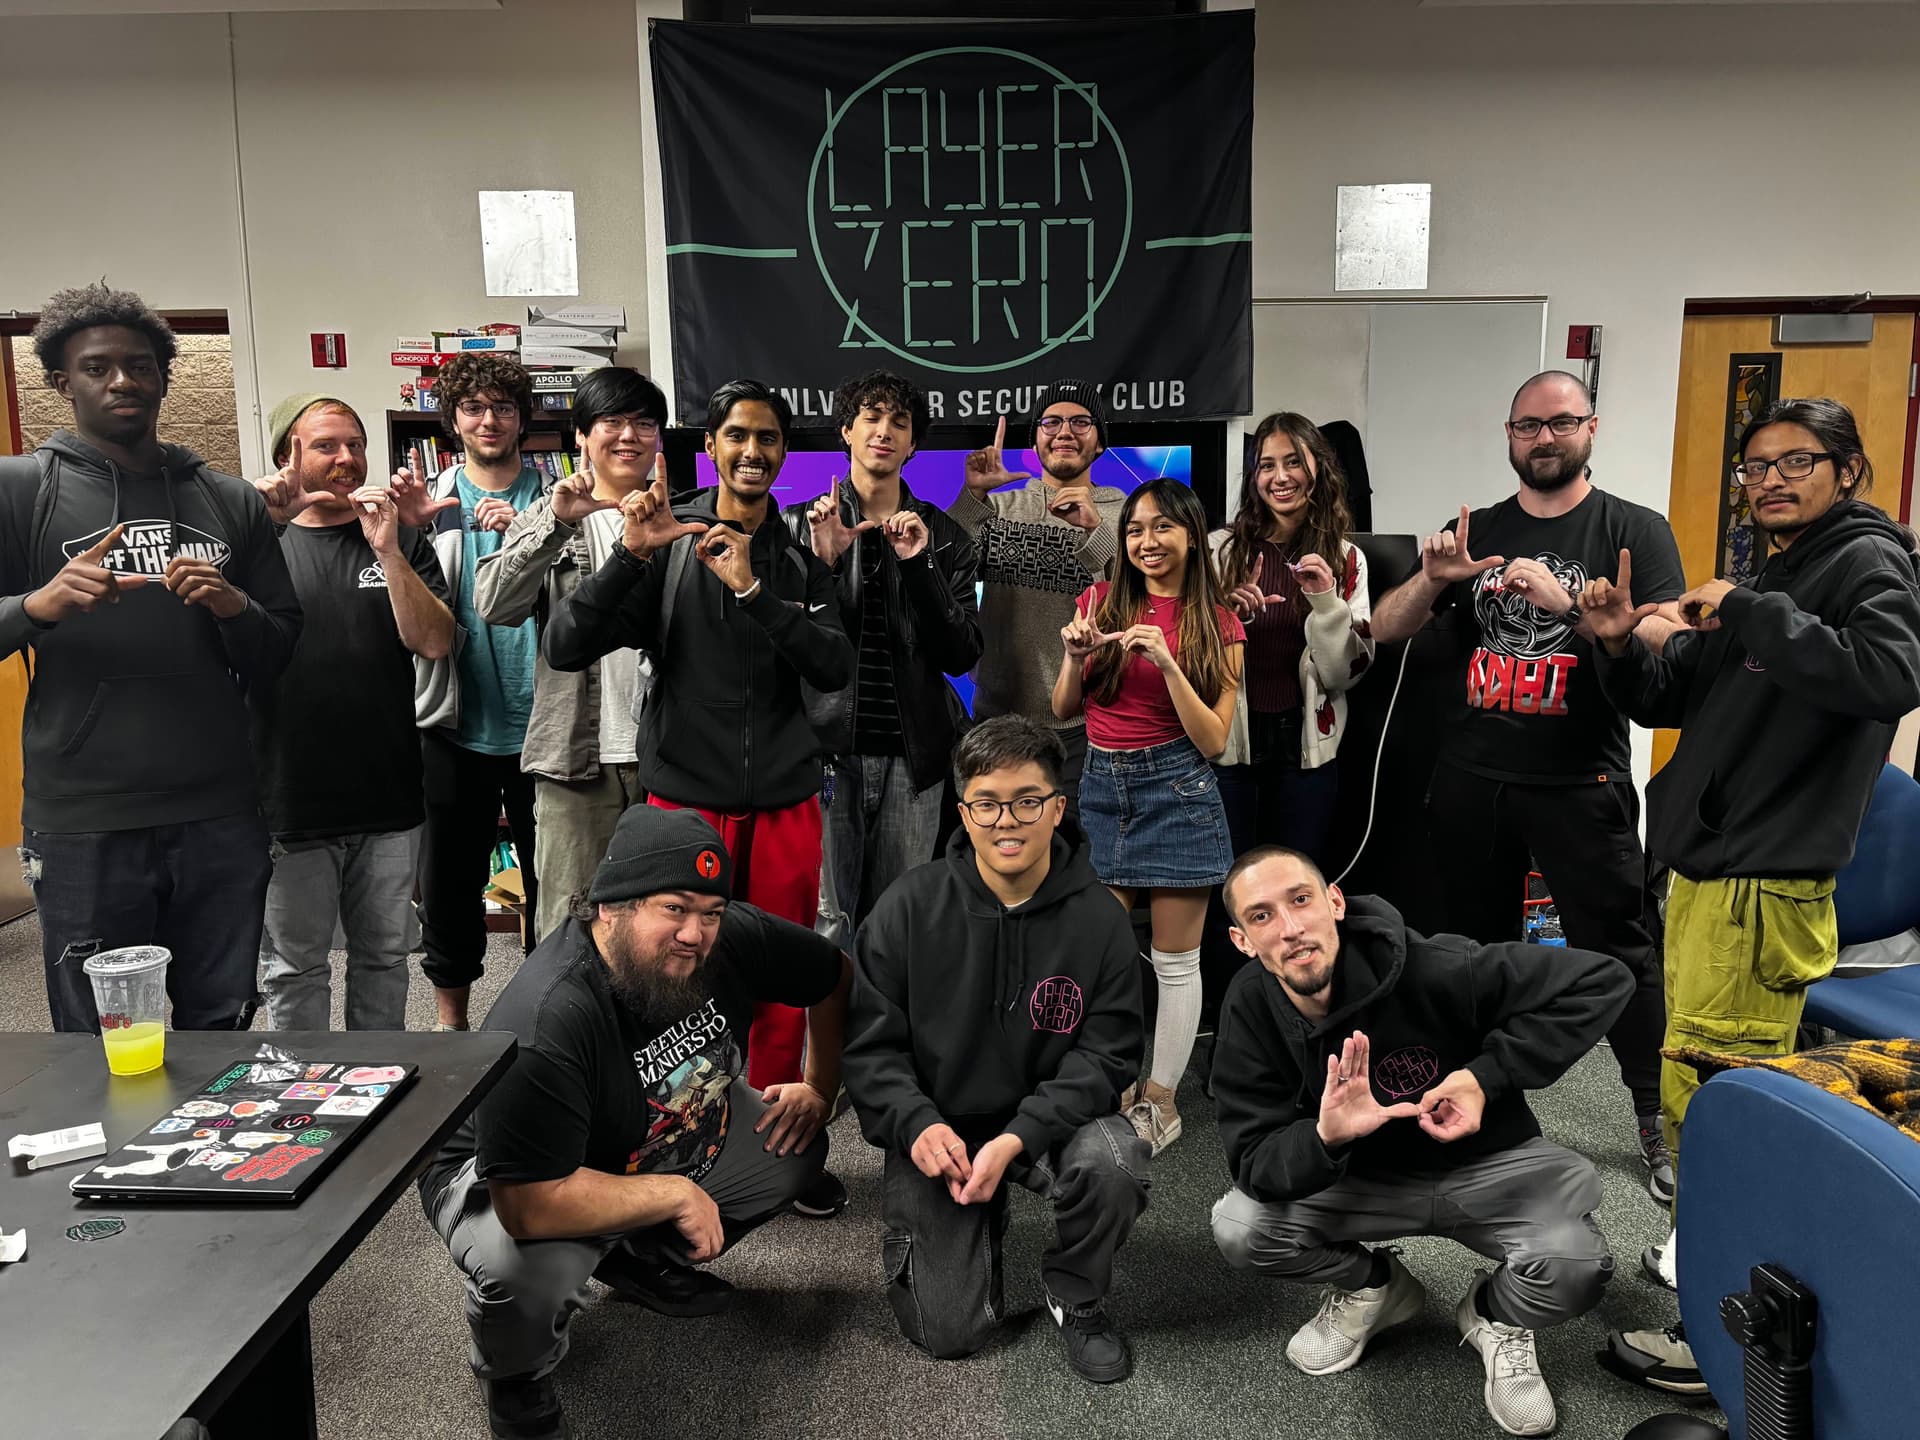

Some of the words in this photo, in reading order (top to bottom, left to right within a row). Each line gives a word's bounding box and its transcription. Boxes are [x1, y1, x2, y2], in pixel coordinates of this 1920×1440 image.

[826, 82, 1098, 212] LAYER
[833, 217, 1095, 348] ZERO
[394, 355, 428, 363] MONOPOLY
[535, 375, 572, 384] APOLLO
[769, 387, 834, 416] NLV
[1112, 380, 1186, 411] CLUB
[1034, 980, 1081, 1010] LAYER
[1032, 1004, 1076, 1034] ZERO
[1381, 1058, 1439, 1100] ZERO
